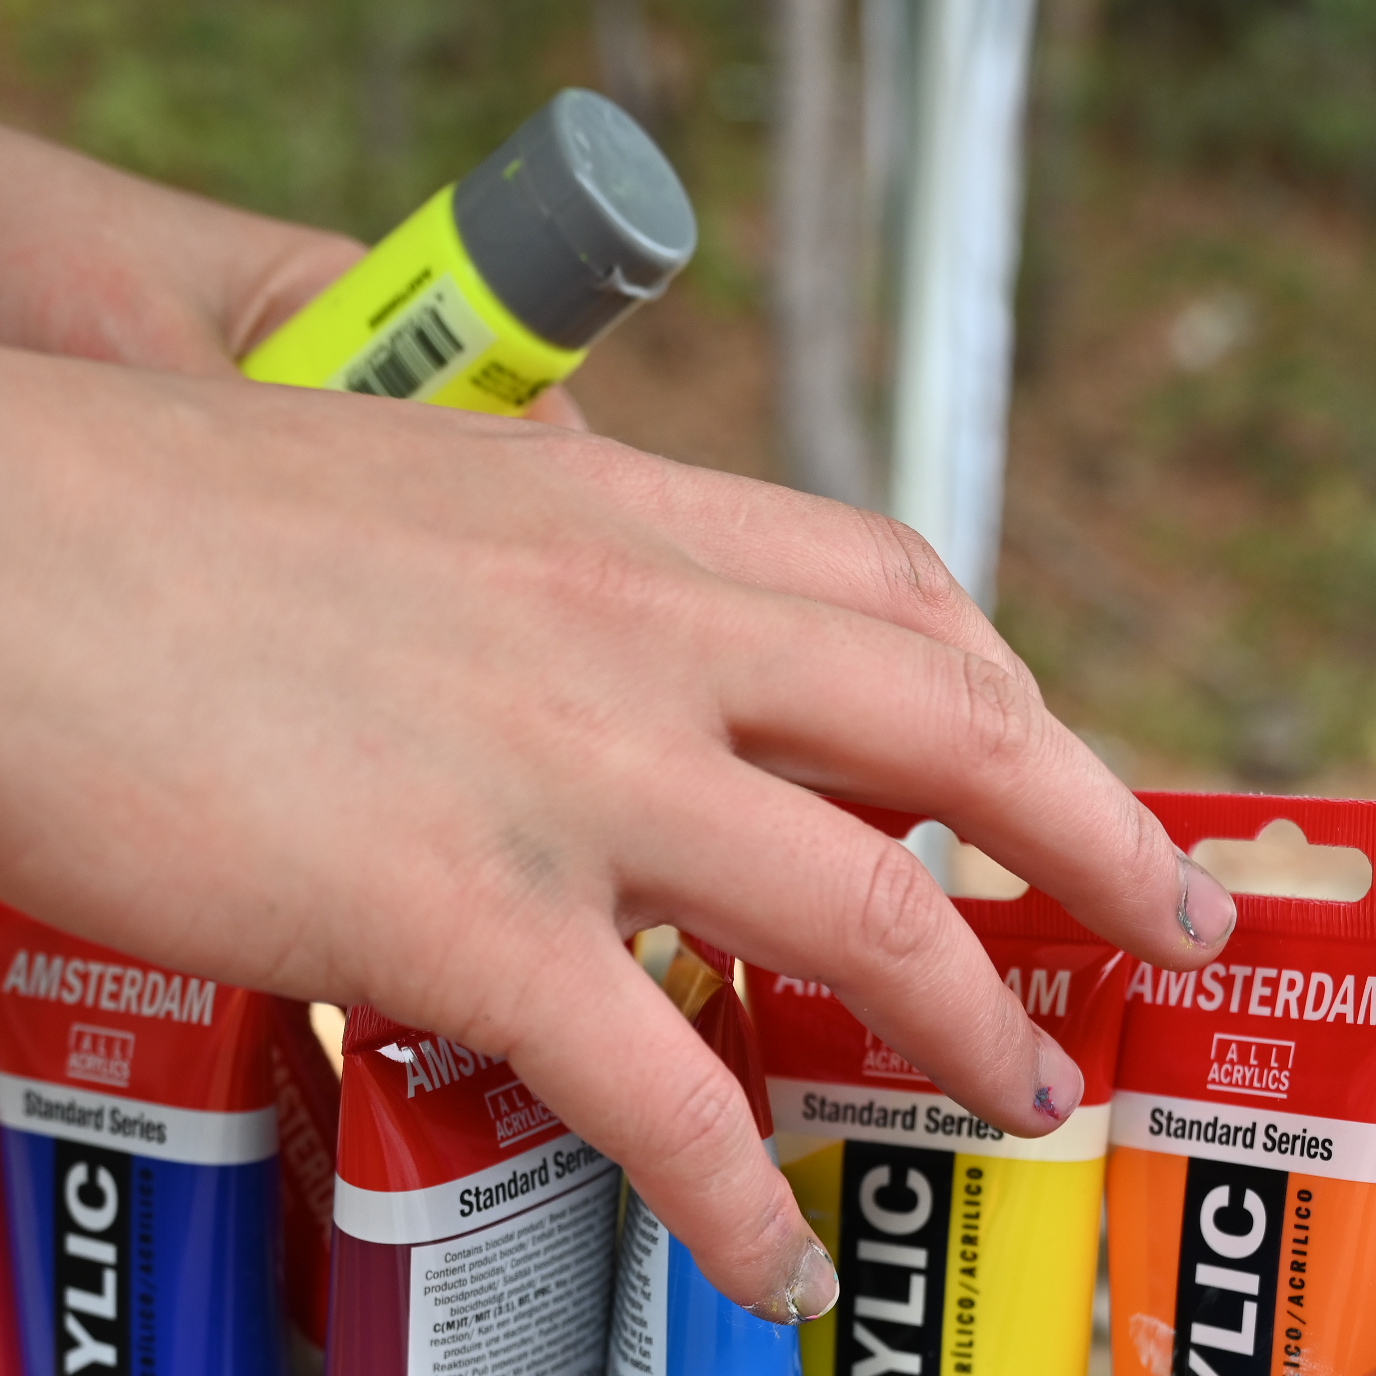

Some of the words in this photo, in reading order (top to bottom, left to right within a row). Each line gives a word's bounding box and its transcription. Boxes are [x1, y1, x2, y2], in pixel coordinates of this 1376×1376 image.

[2, 950, 216, 1027] AMSTERDAM
[1226, 1043, 1288, 1070] ALL
[1207, 1063, 1290, 1092] ACRYLICS
[23, 1090, 106, 1132] Standard
[109, 1108, 168, 1145] Series
[802, 1092, 917, 1132] Standard
[924, 1107, 1005, 1141] Series
[1149, 1107, 1256, 1150] Standard
[1261, 1123, 1334, 1162] Series
[460, 1156, 549, 1218] Standard
[445, 1244, 484, 1263] Contains
[486, 1232, 515, 1251] biocidal
[425, 1264, 466, 1281] Contient
[469, 1253, 498, 1271] produit
[424, 1278, 468, 1296] producto
[430, 1325, 476, 1347] reaction/
[443, 1341, 483, 1360] produire
[433, 1352, 487, 1373] Reaktionen
